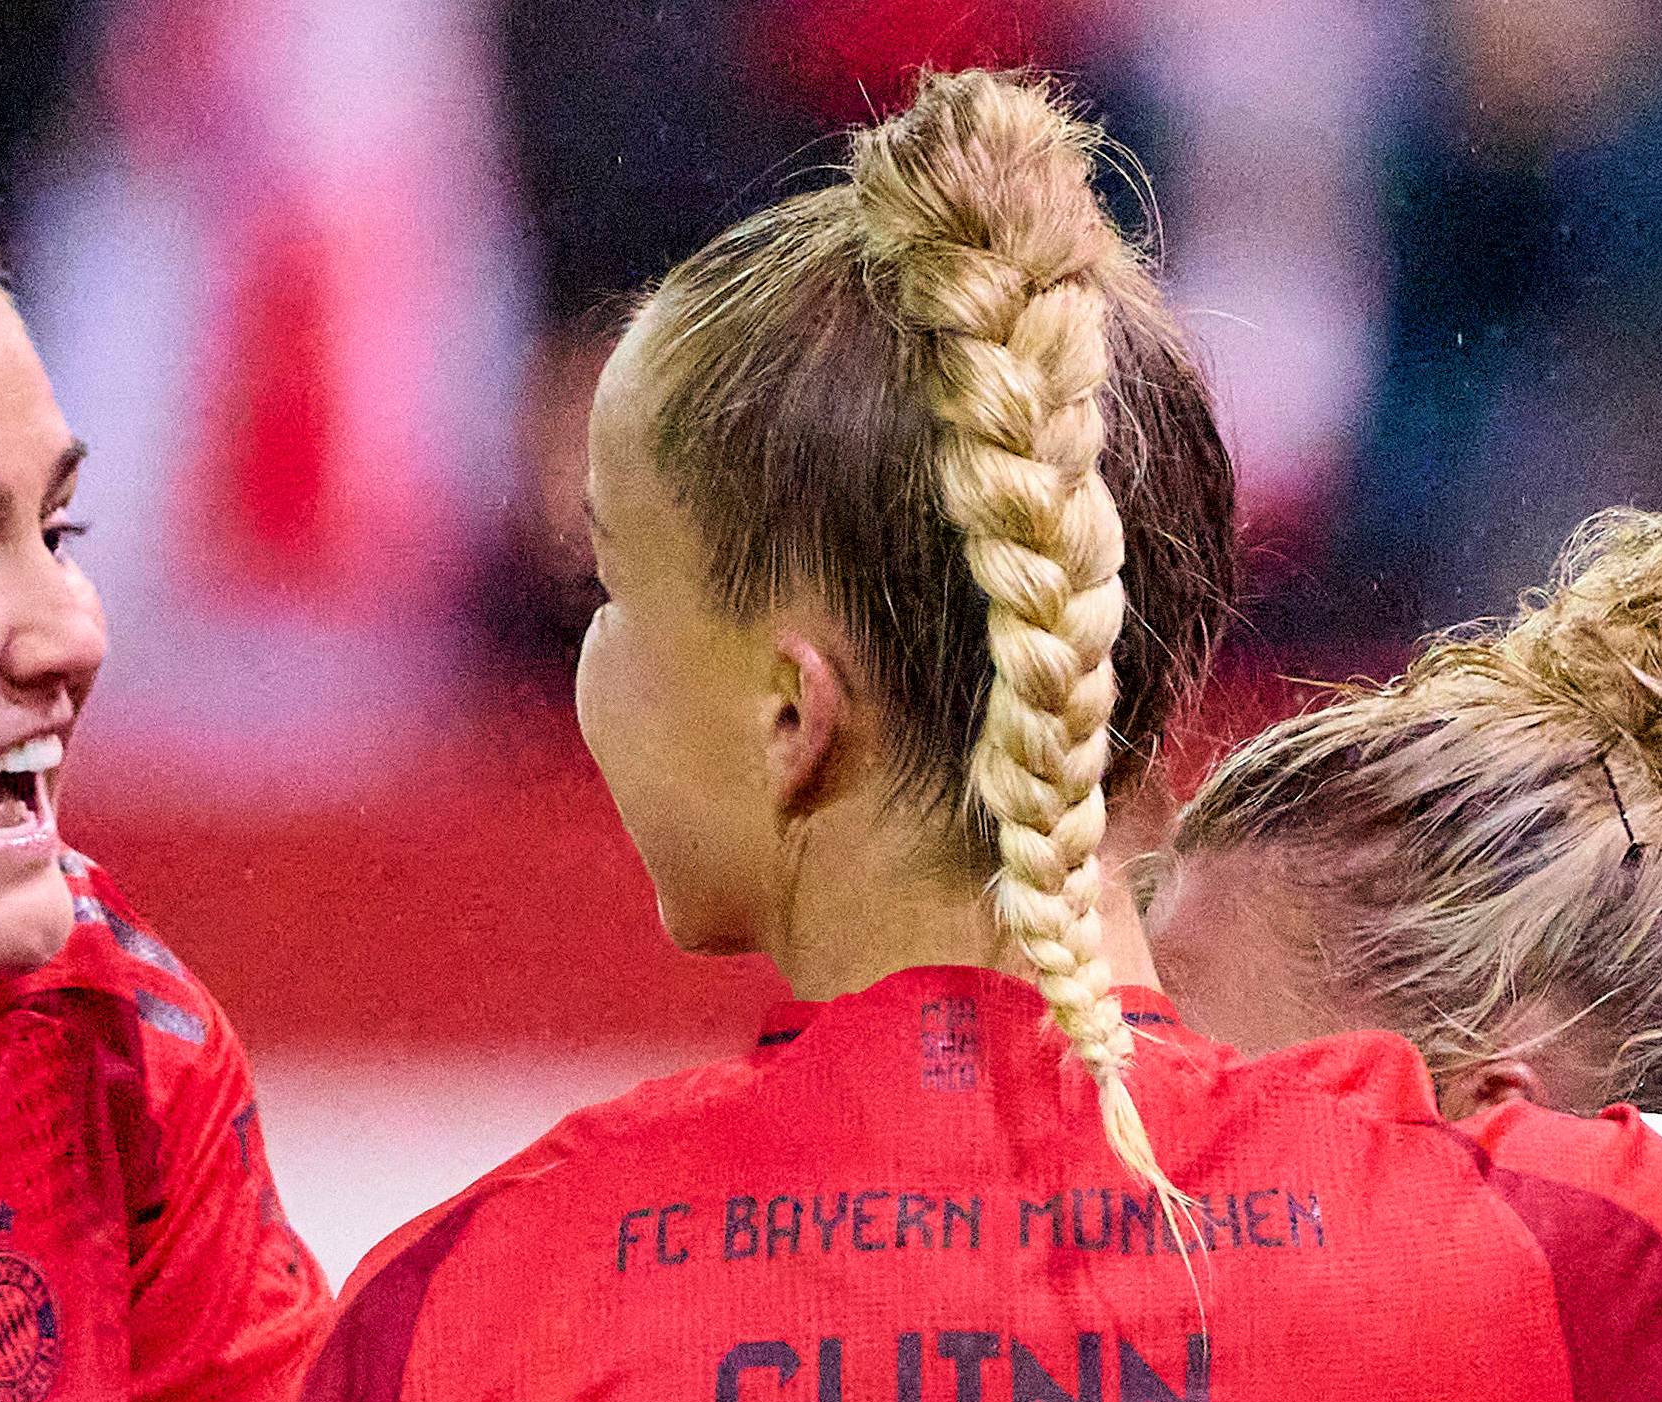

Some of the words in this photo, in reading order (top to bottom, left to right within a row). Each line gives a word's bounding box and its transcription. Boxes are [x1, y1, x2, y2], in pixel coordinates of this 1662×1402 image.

[616, 1202, 692, 1273] FC
[724, 1190, 982, 1261] BAYERN
[1019, 1187, 1326, 1257] MÜNCHEN
